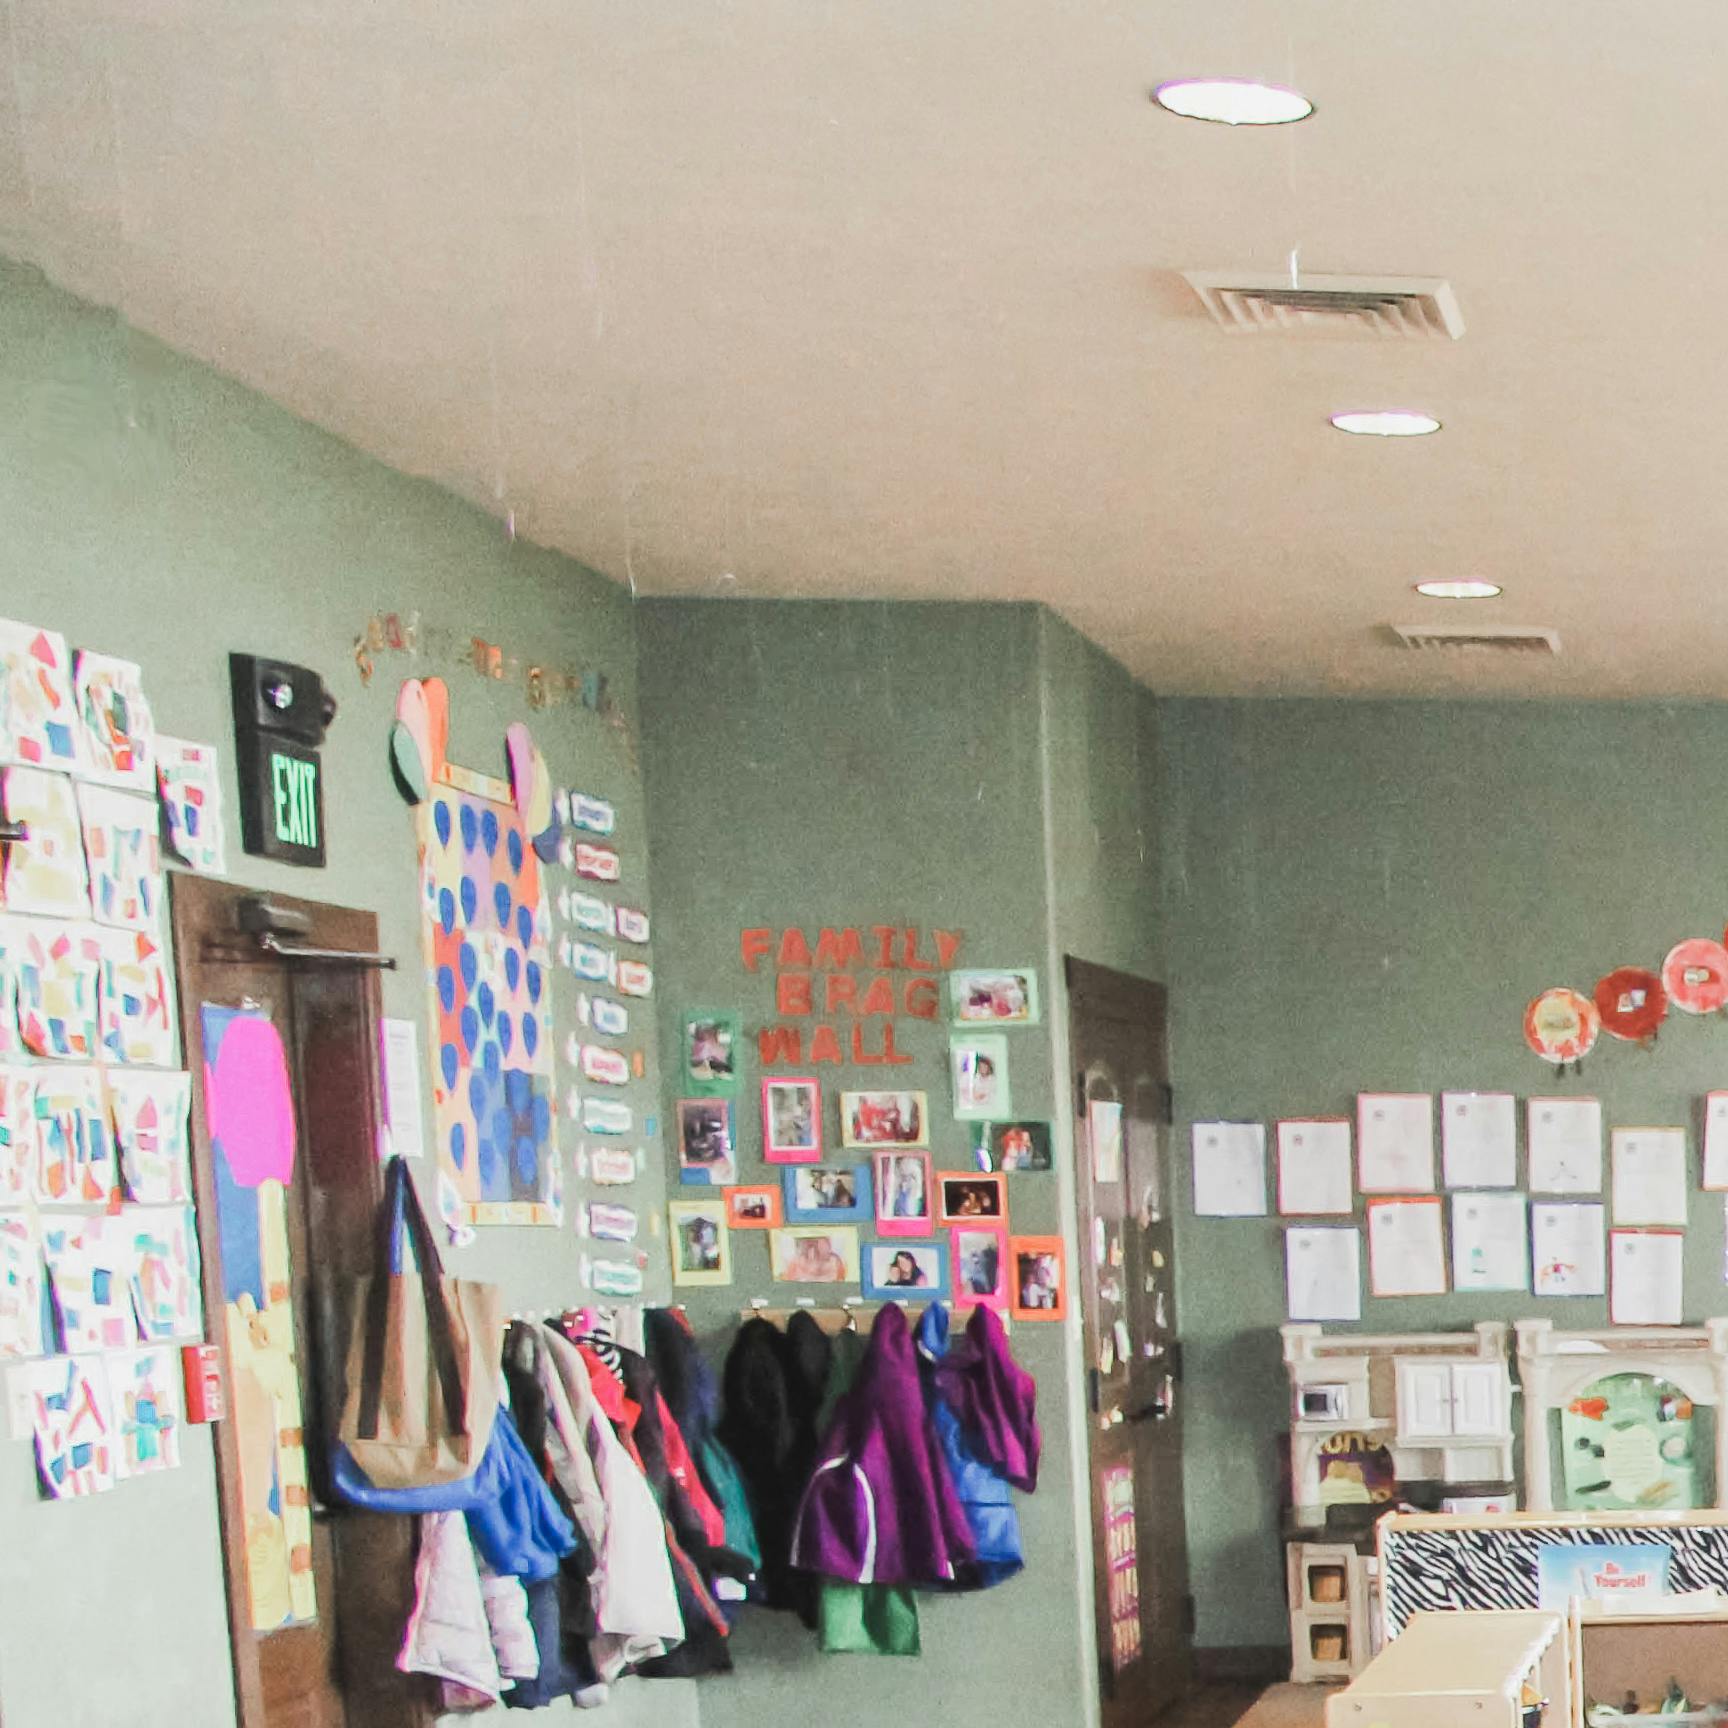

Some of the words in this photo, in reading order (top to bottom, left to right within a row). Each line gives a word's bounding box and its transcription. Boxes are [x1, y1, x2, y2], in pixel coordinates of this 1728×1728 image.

[272, 753, 316, 848] EXIT
[741, 926, 962, 972] FAMILY
[778, 973, 940, 1020] BRAG
[758, 1023, 913, 1066] WALL
